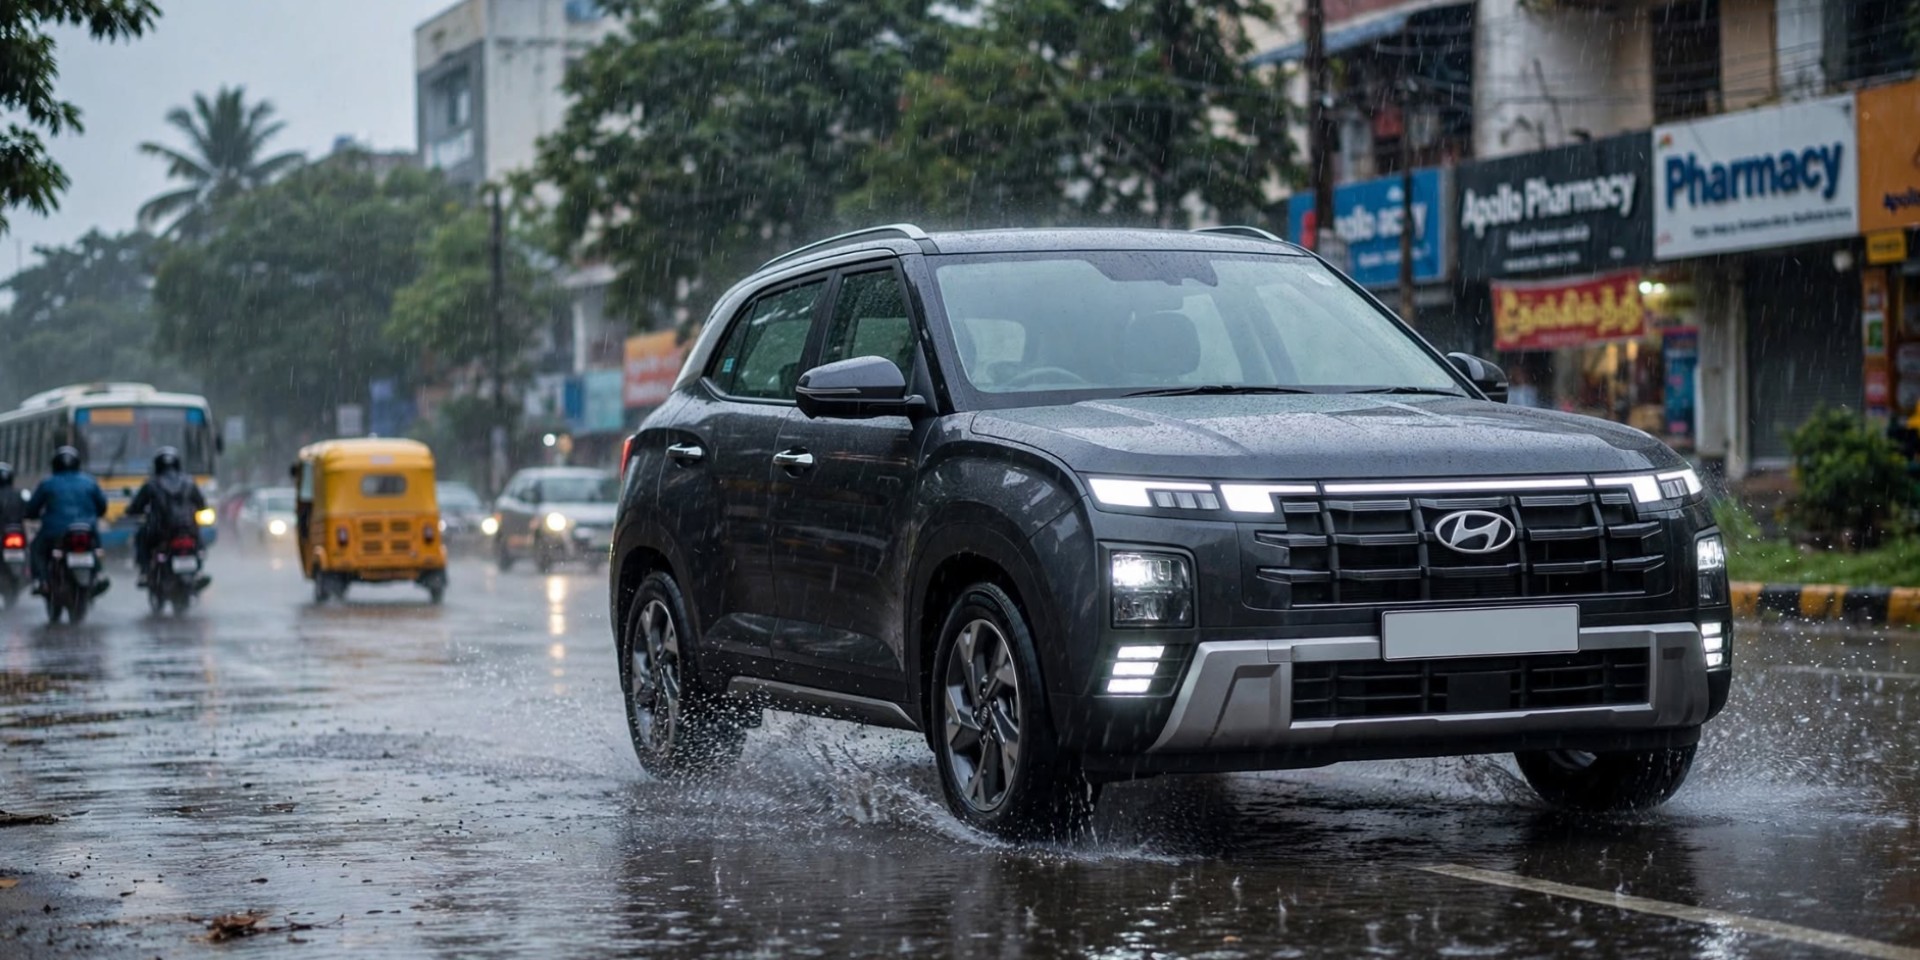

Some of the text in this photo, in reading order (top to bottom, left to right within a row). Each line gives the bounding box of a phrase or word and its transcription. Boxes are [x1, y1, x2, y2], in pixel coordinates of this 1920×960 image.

[1462, 182, 1523, 239] Apollo
[1524, 172, 1636, 219] Pharmacy
[1665, 141, 1843, 209] Pharmacy
